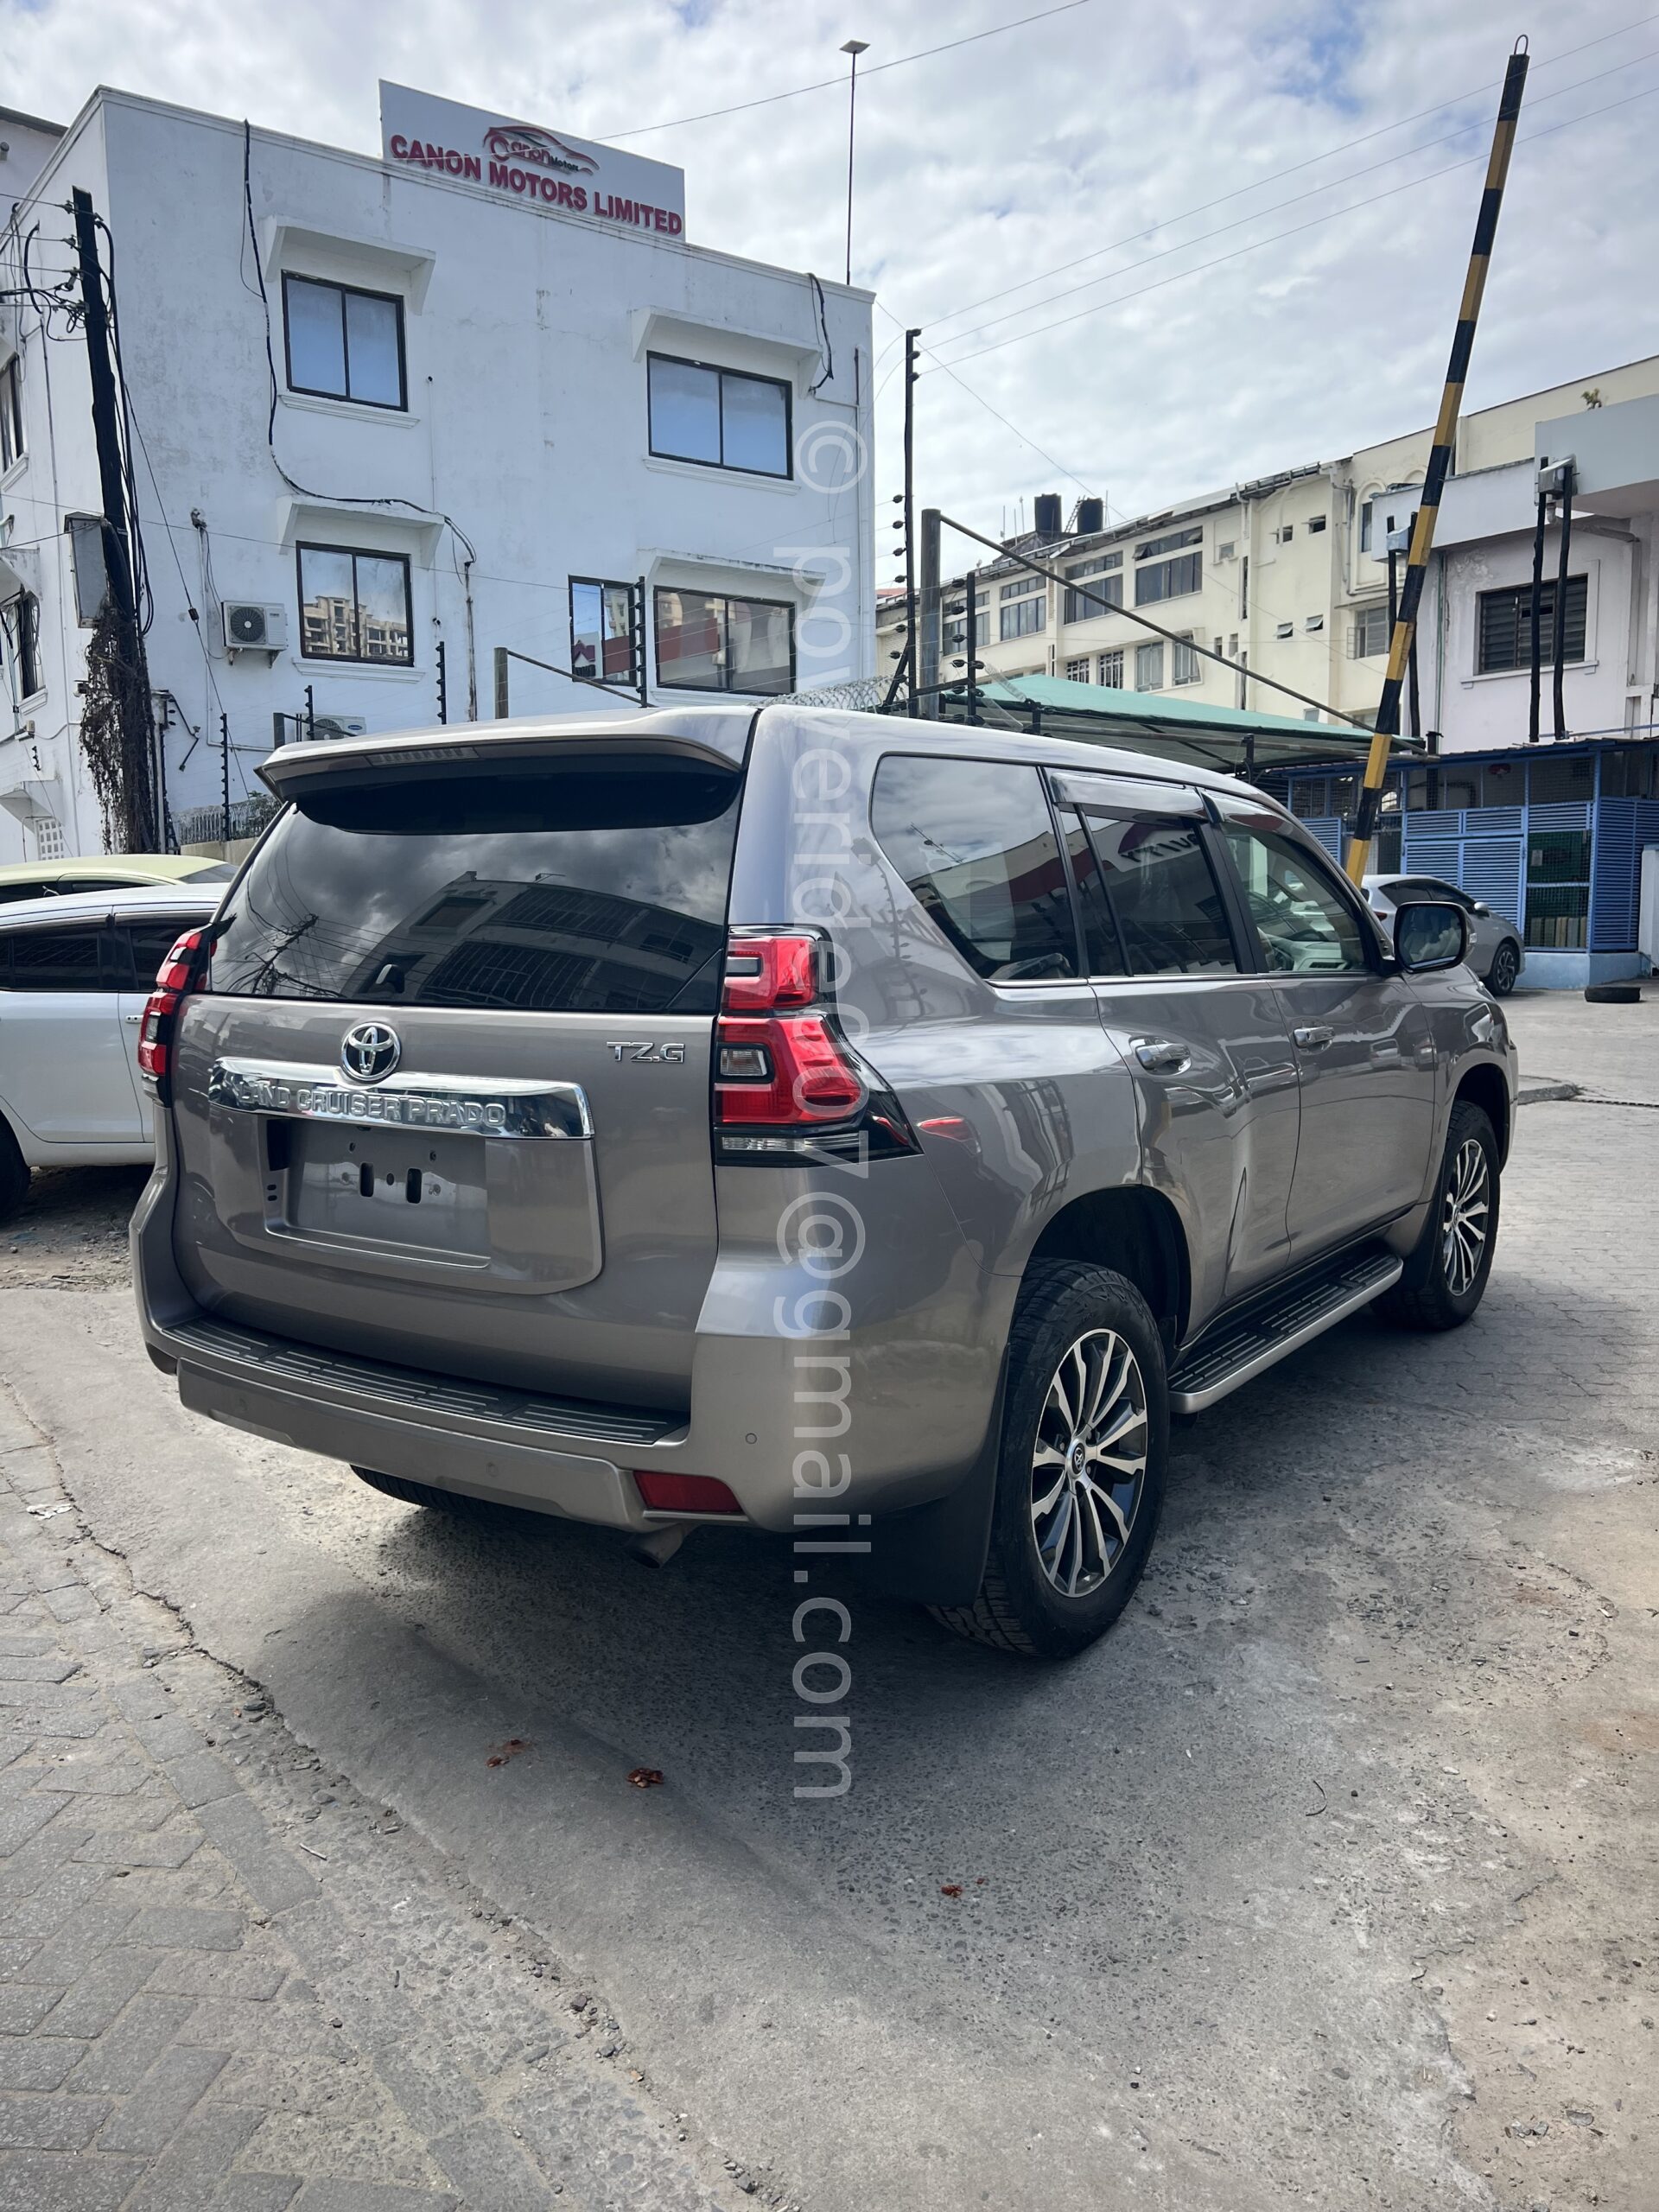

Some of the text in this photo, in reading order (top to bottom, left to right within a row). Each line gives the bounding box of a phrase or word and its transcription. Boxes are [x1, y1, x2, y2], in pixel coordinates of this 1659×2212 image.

[391, 134, 683, 236] CANON MOTORS LIMITED
[297, 1088, 401, 1121] CRUISER
[408, 1097, 507, 1127] PRADO
